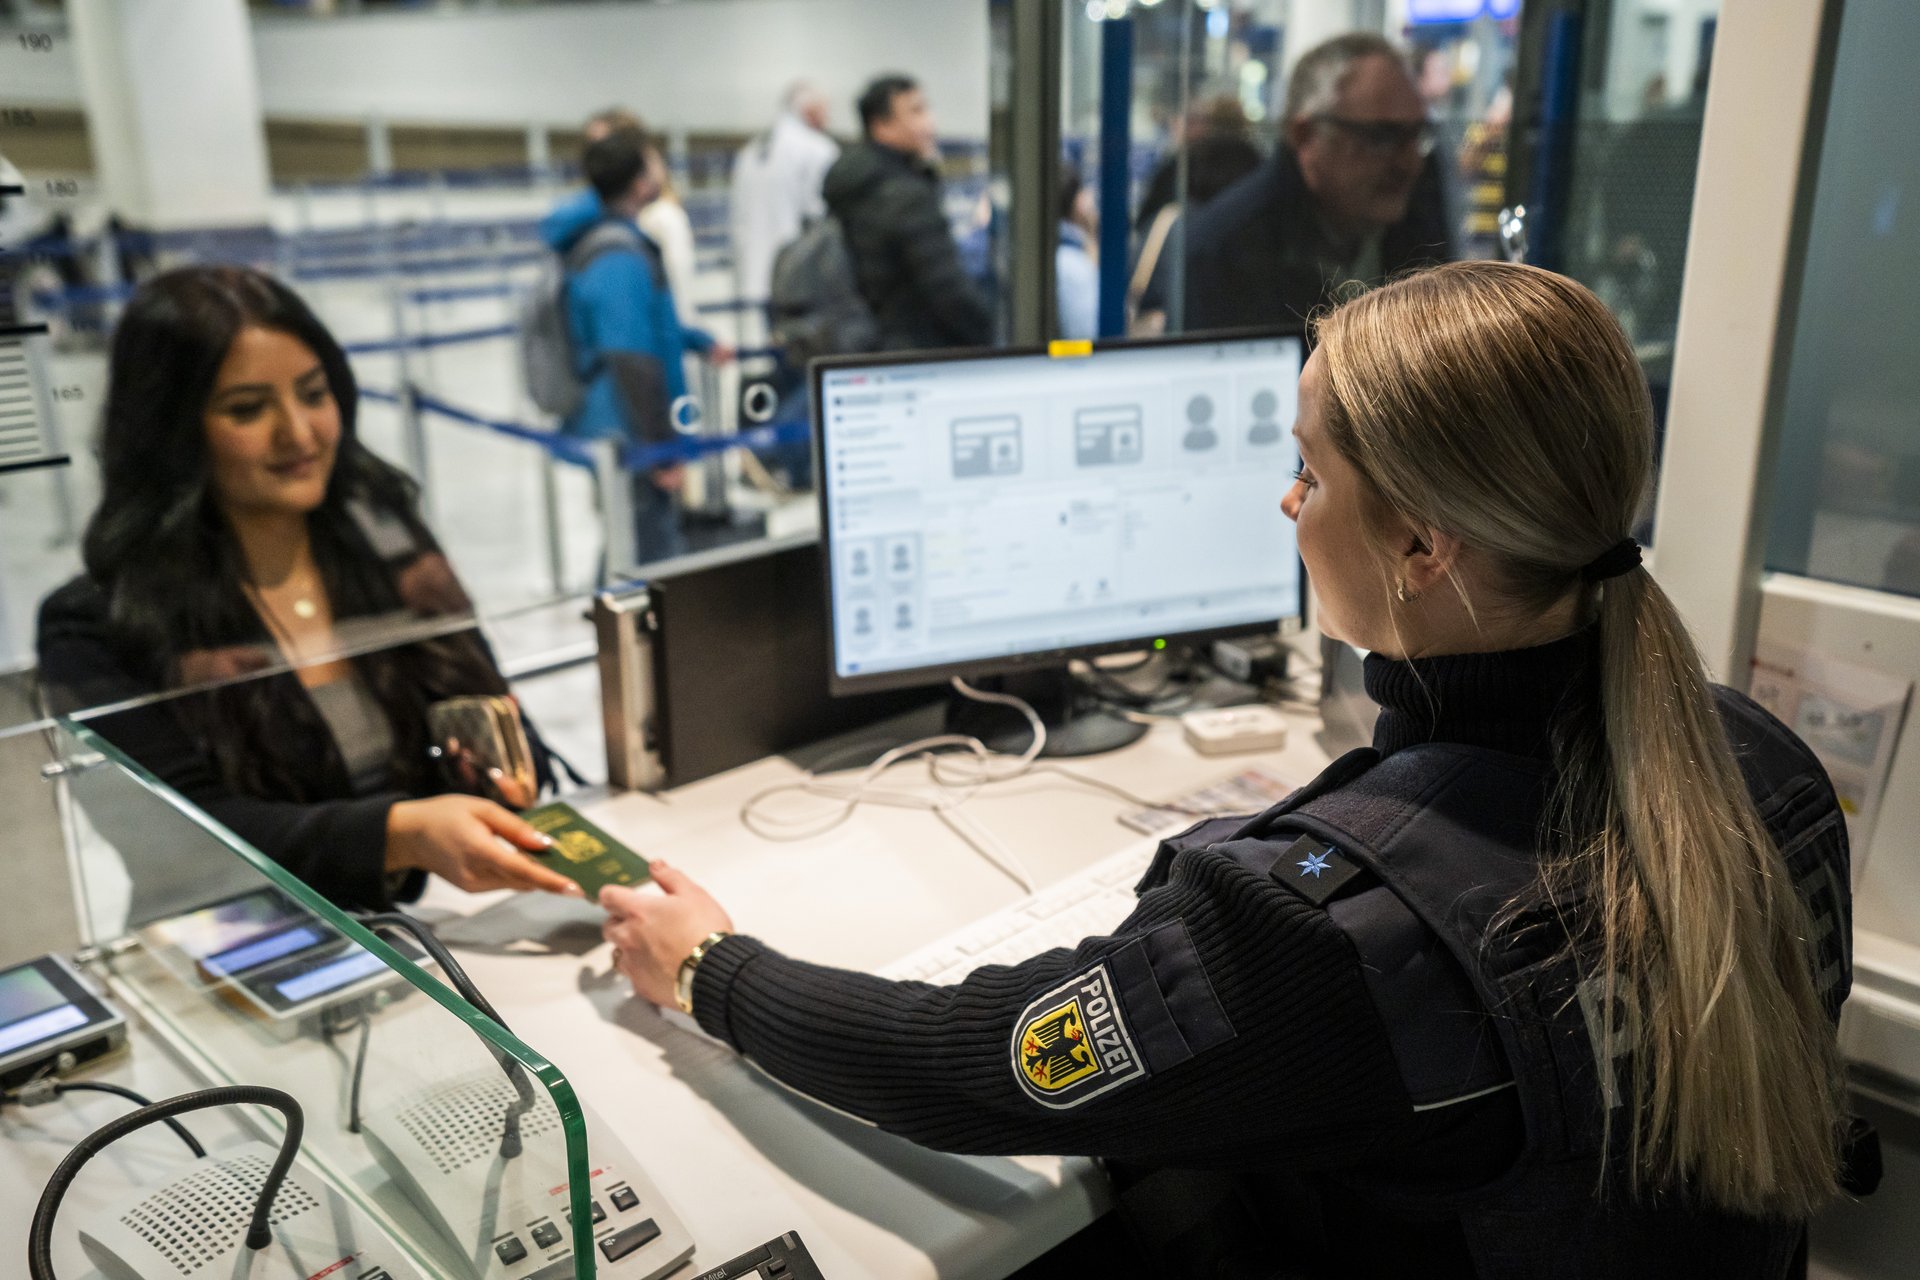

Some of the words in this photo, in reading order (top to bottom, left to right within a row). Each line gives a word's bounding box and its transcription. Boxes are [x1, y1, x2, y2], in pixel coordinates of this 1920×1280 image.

[18, 33, 52, 51] 190
[1081, 979, 1132, 1074] POLIZEI
[703, 1268, 727, 1280] Mitel
